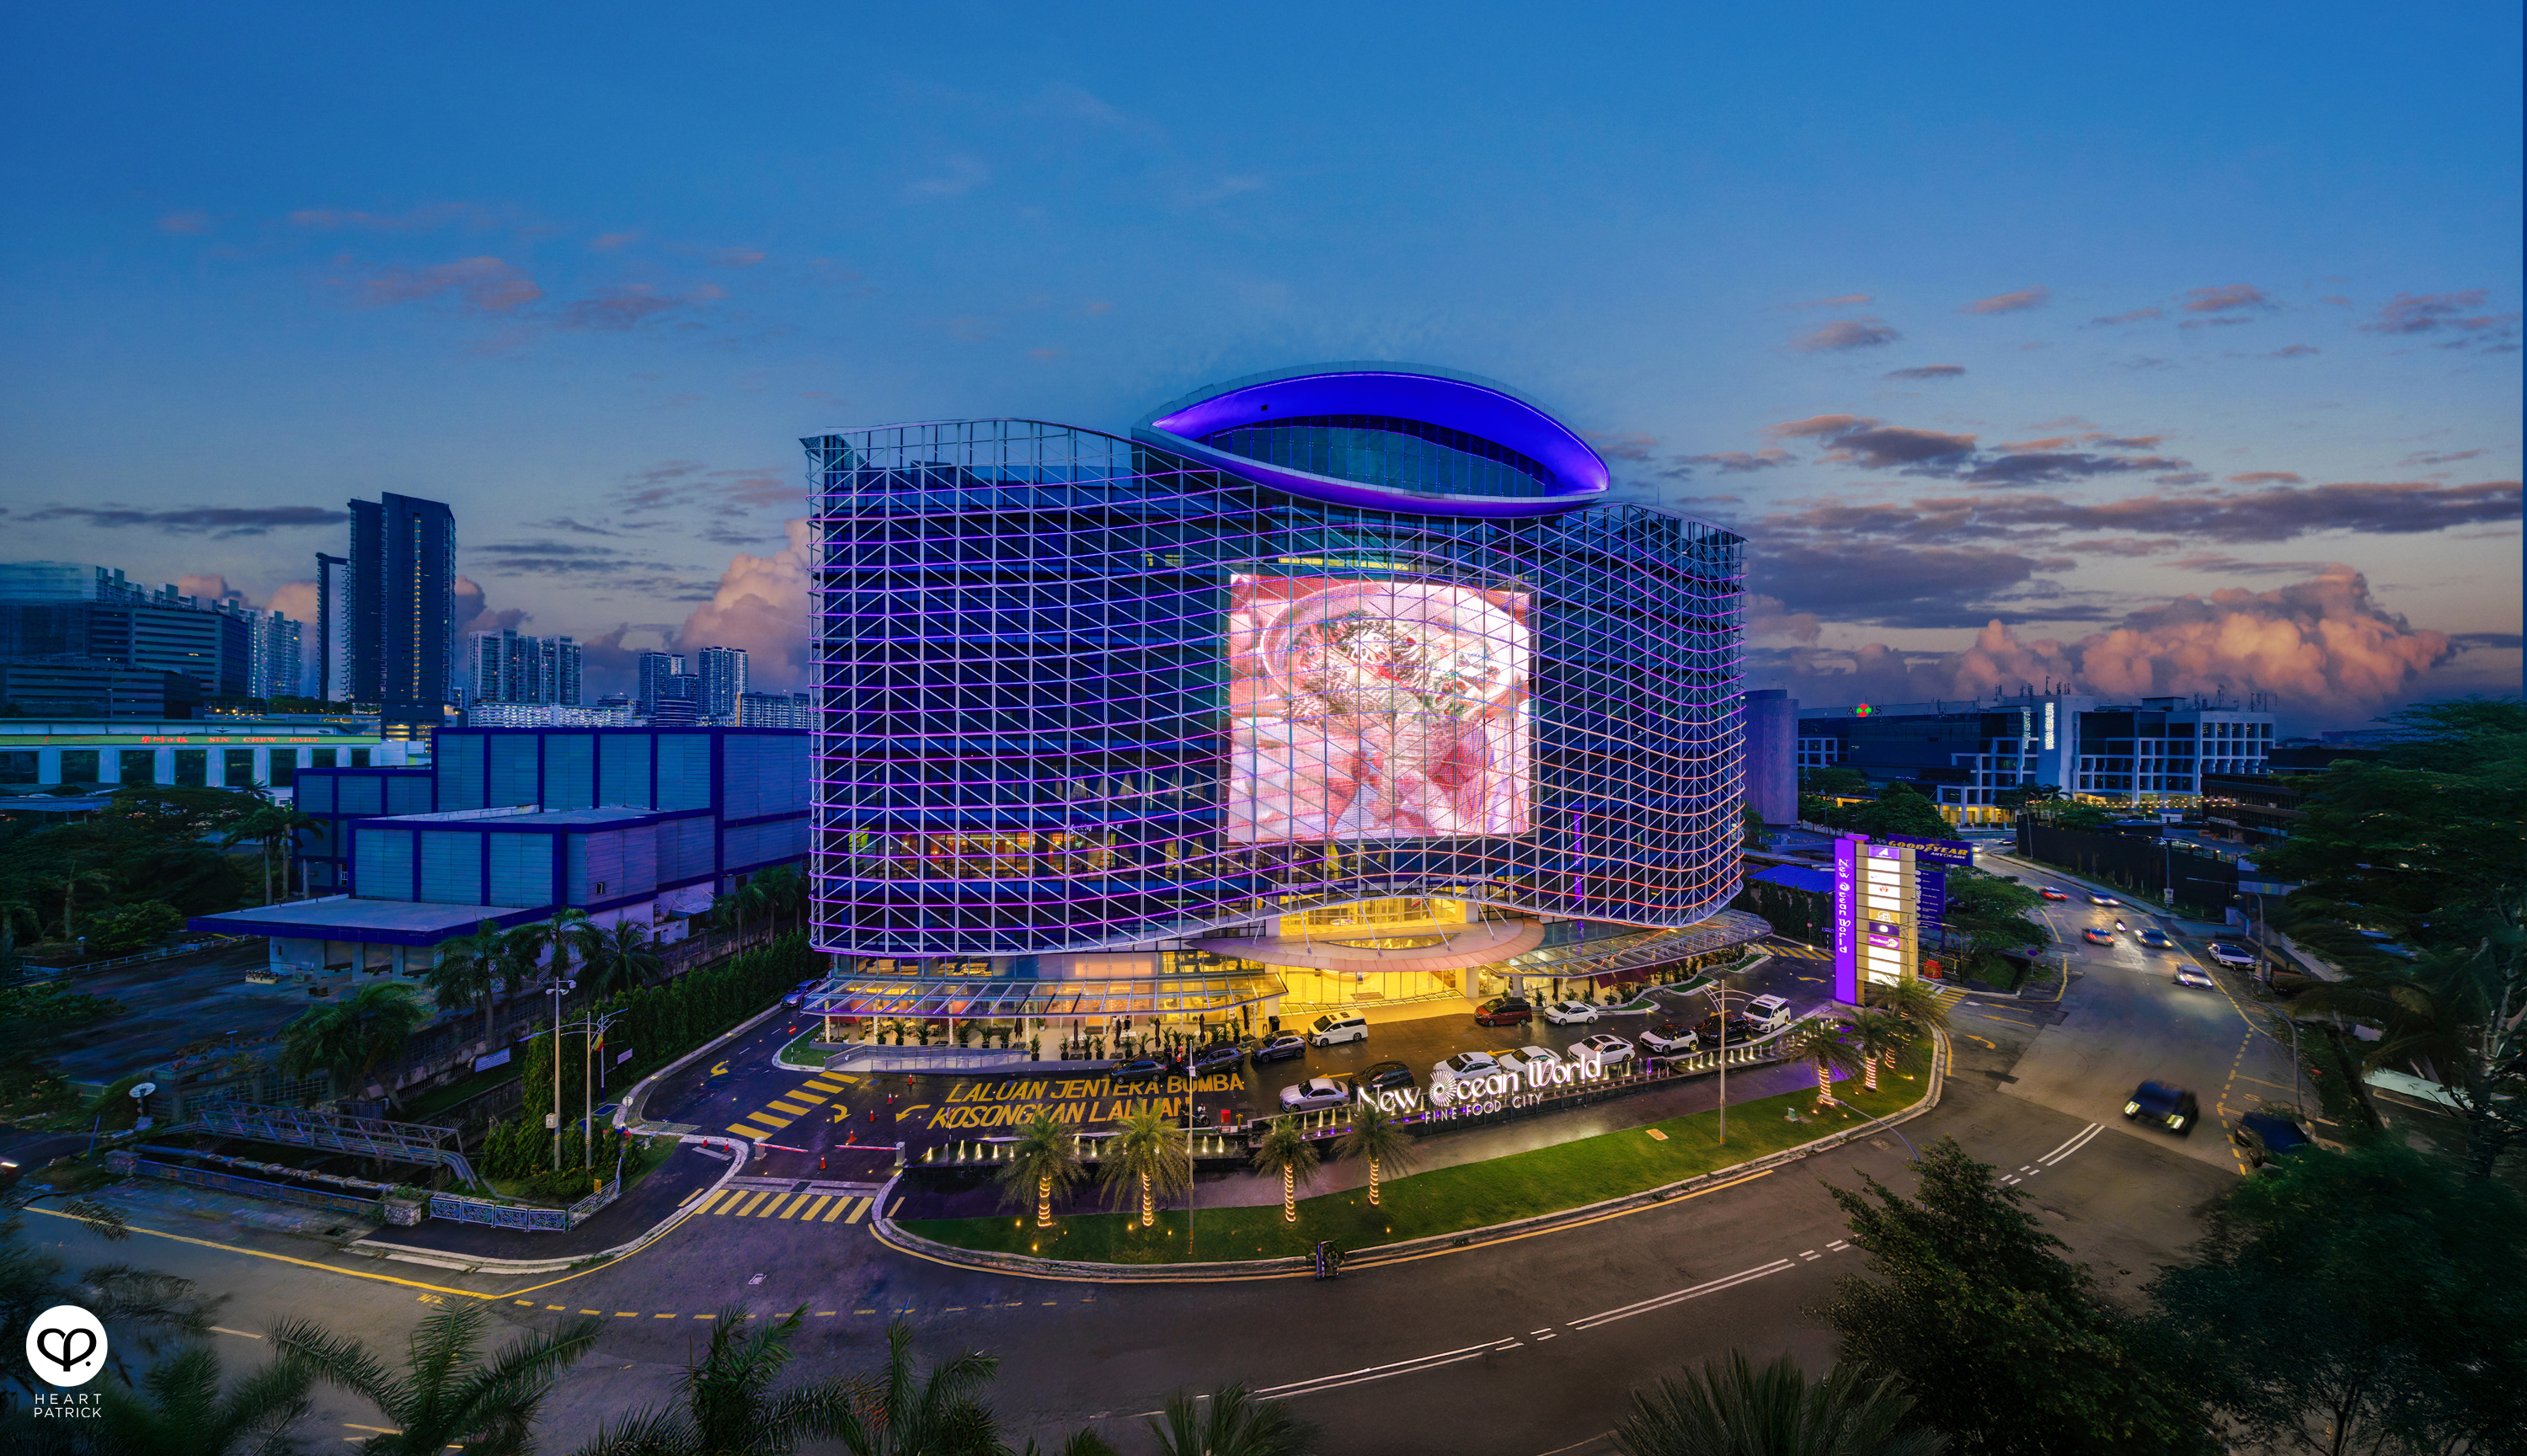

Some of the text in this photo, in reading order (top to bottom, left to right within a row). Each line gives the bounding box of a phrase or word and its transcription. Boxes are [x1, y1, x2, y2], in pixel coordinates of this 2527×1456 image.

[1888, 840, 1969, 856] GOODYEAR
[1838, 858, 1850, 878] New
[1838, 918, 1851, 953] World
[945, 1072, 1245, 1103] LALUAN JENTERA BUMBA
[1356, 1084, 1421, 1113] New
[1528, 1051, 1601, 1088] World
[927, 1101, 1087, 1129] KOSONGKAN
[1424, 1091, 1544, 1124] FINE FOOD CITY
